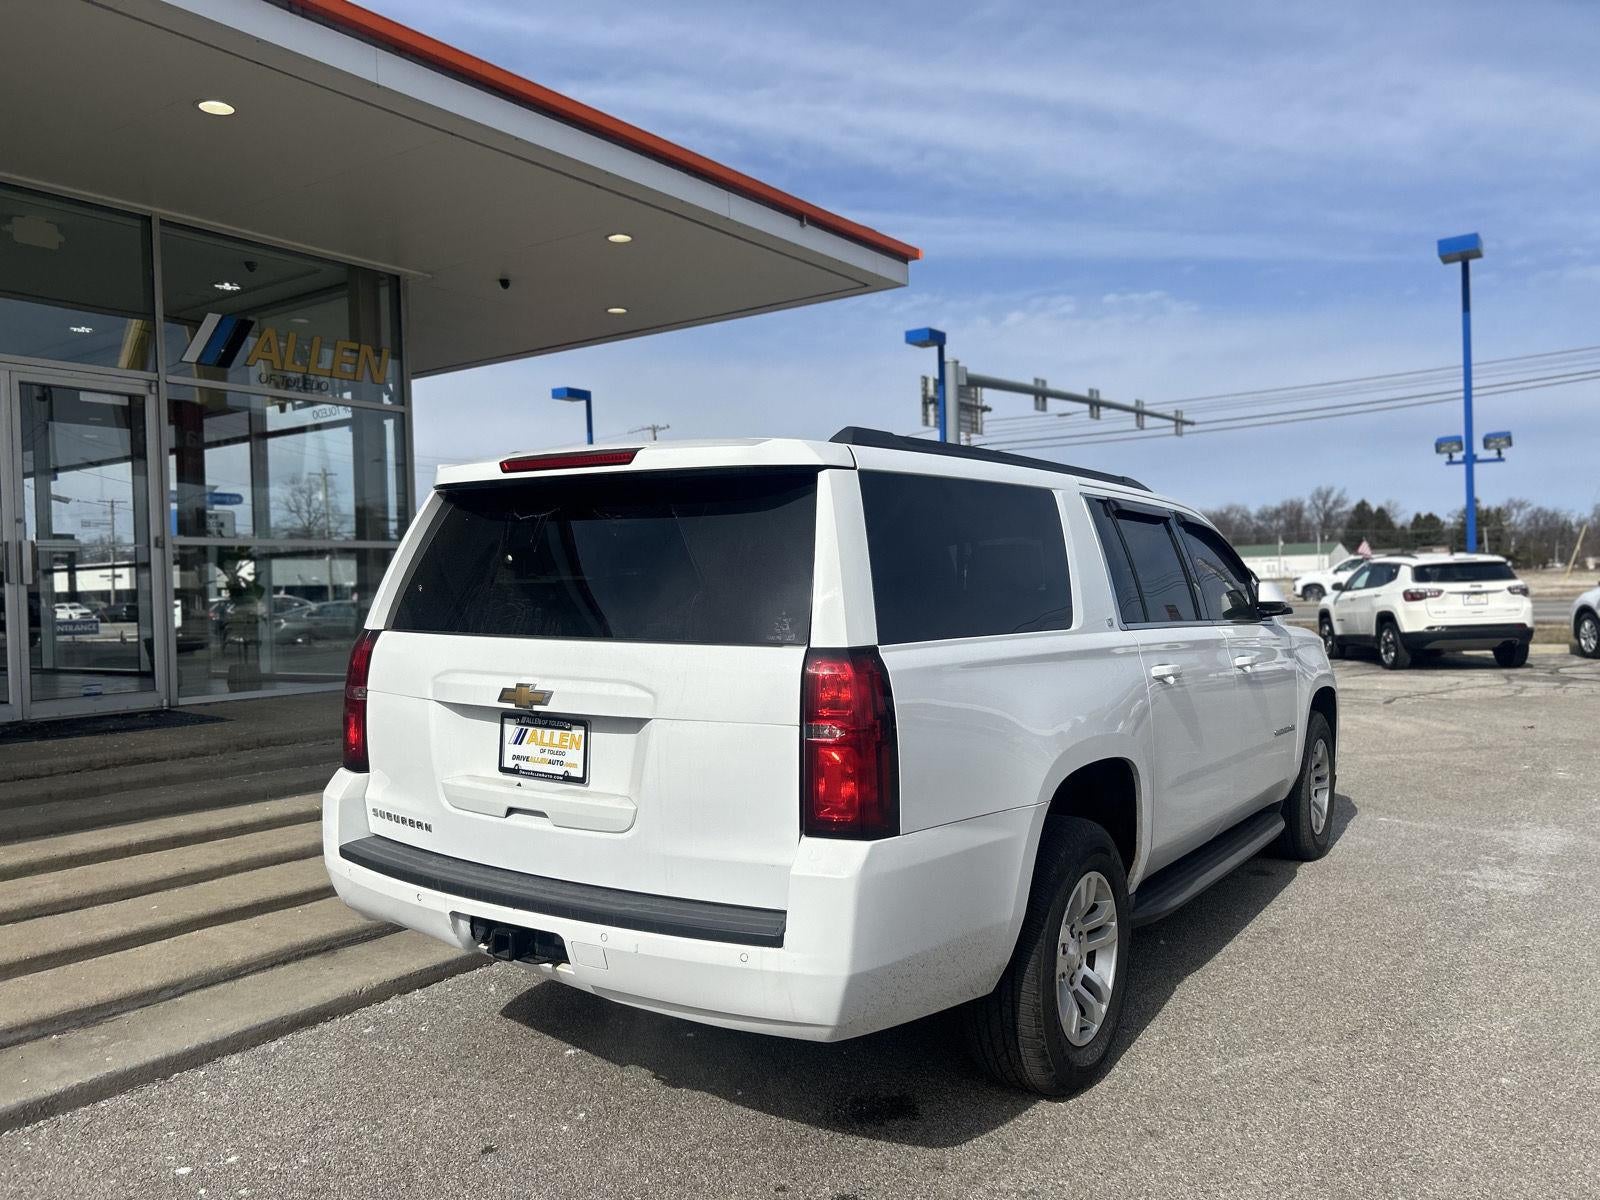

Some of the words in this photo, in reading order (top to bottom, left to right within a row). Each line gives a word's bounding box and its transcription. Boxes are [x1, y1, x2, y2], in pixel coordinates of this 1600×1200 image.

[246, 327, 390, 384] ALLEN
[258, 373, 277, 385] OF
[279, 375, 329, 392] TOLEDO
[56, 624, 98, 632] NTRANCE
[526, 729, 582, 750] ALLEN
[372, 808, 433, 833] SUBURBAN
